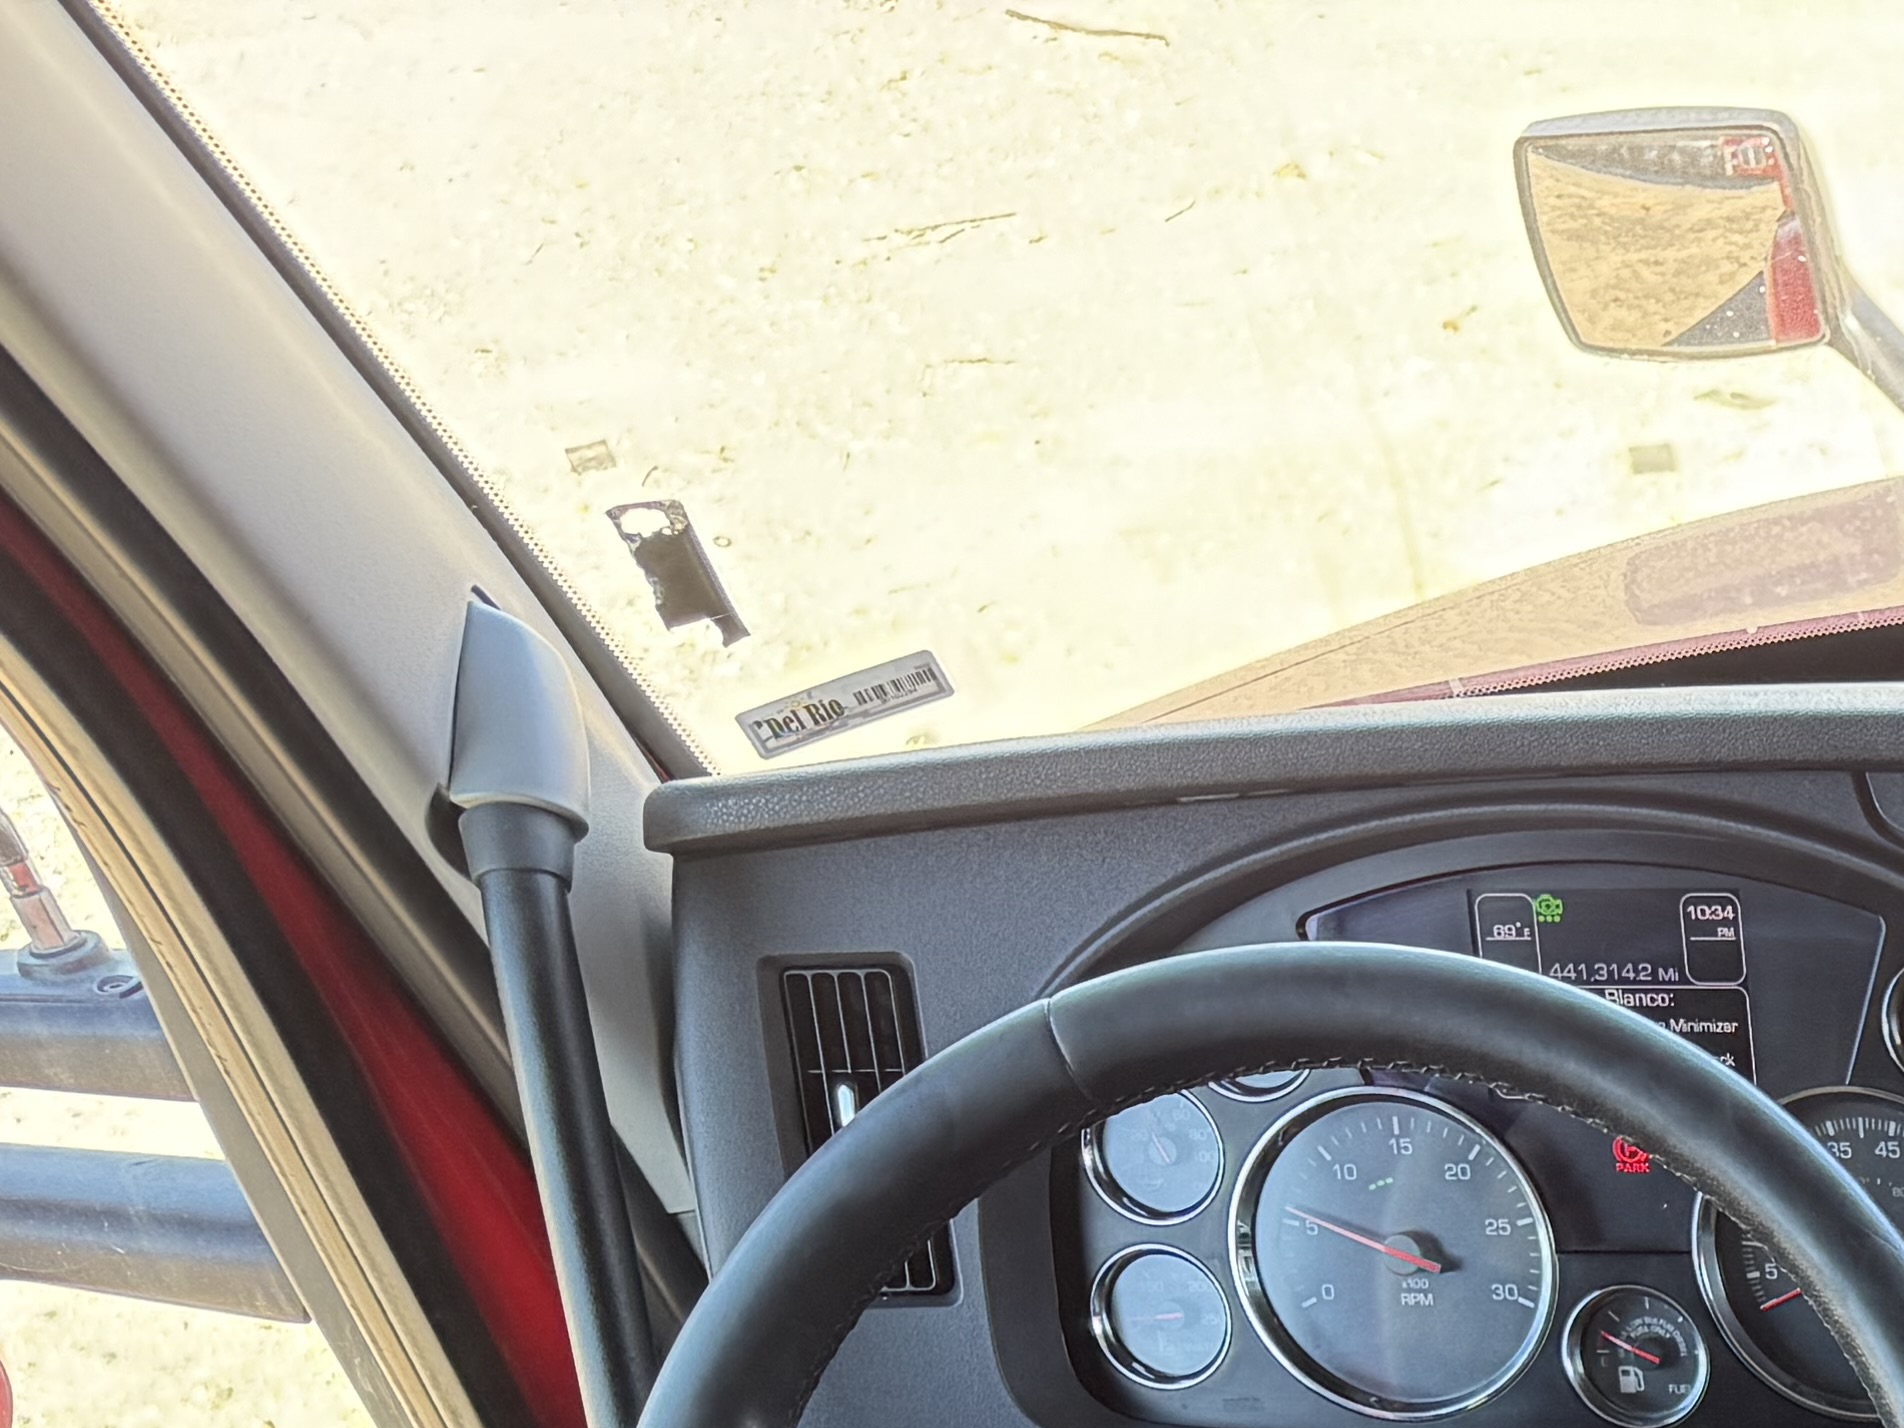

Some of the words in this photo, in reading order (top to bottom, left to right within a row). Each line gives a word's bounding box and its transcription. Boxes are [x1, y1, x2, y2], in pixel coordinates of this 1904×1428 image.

[769, 708, 806, 740] Del
[1686, 905, 1736, 920] 10:34
[1716, 927, 1735, 938] PM
[1658, 967, 1680, 982] Mi
[1670, 1018, 1739, 1034] Minimizer
[1390, 1138, 1413, 1155] 15
[1875, 1142, 1901, 1158] 45
[1333, 1164, 1357, 1180] 10
[1444, 1164, 1471, 1180] 20
[1305, 1219, 1319, 1236] 5
[1485, 1219, 1511, 1236] 25
[1765, 1262, 1778, 1280] 5
[1322, 1284, 1334, 1300] 0
[1402, 1293, 1434, 1306] RPM
[1492, 1284, 1519, 1300] 30
